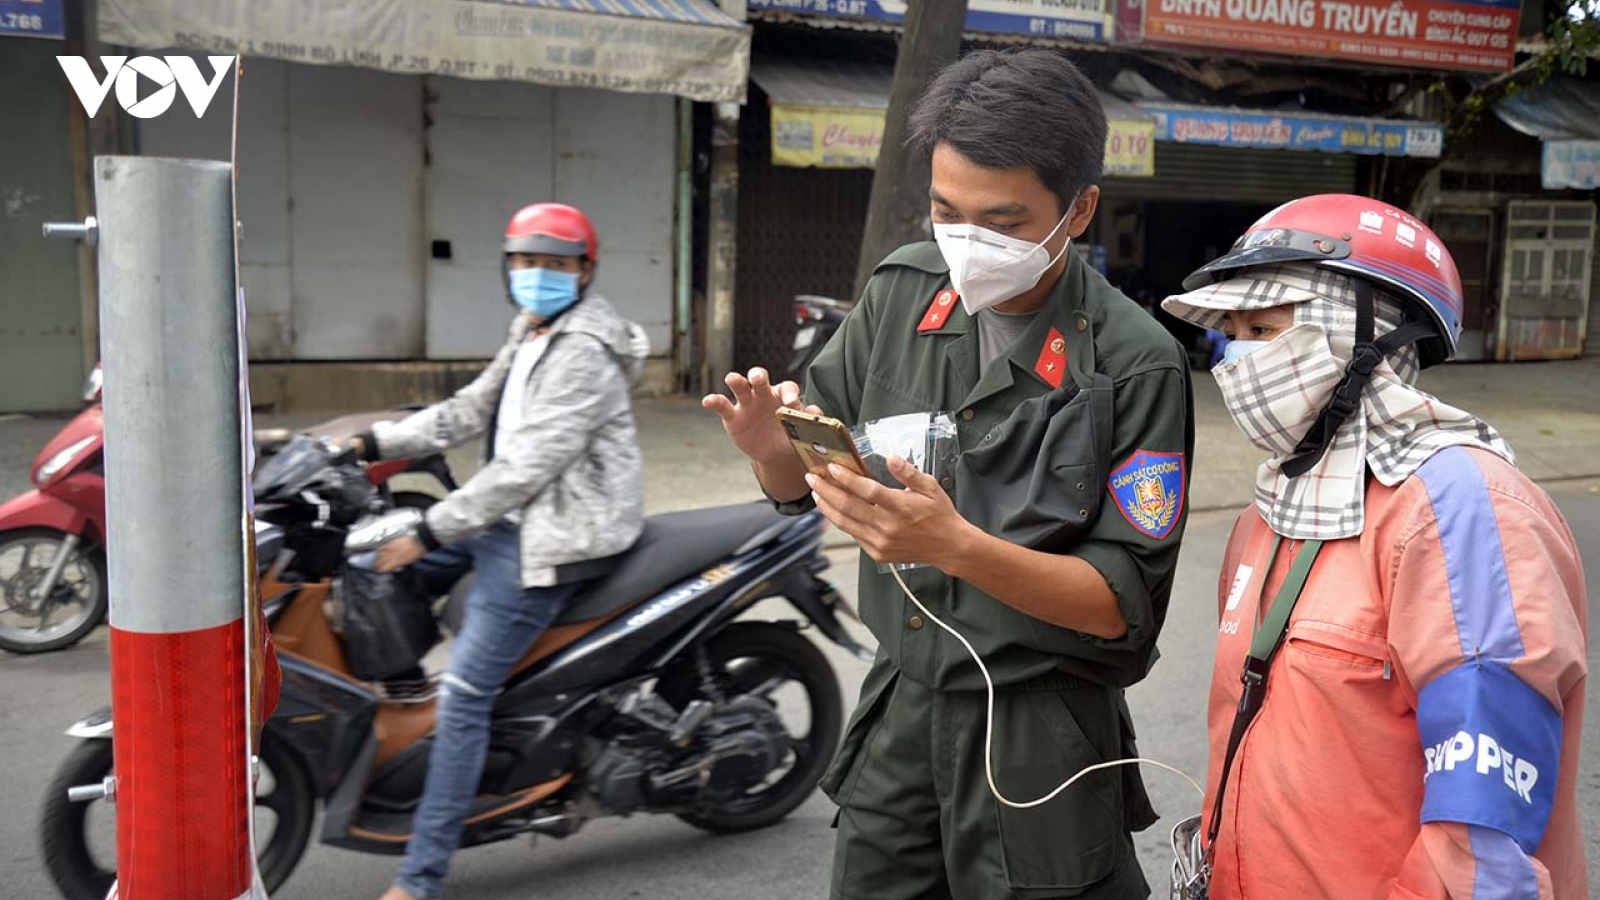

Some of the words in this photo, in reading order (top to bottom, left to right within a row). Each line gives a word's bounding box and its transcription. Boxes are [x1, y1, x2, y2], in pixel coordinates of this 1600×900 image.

[0, 13, 42, 30] .768
[1226, 0, 1316, 28] QUANG
[1174, 118, 1229, 142] QUANG
[1133, 466, 1147, 482] SÁT
